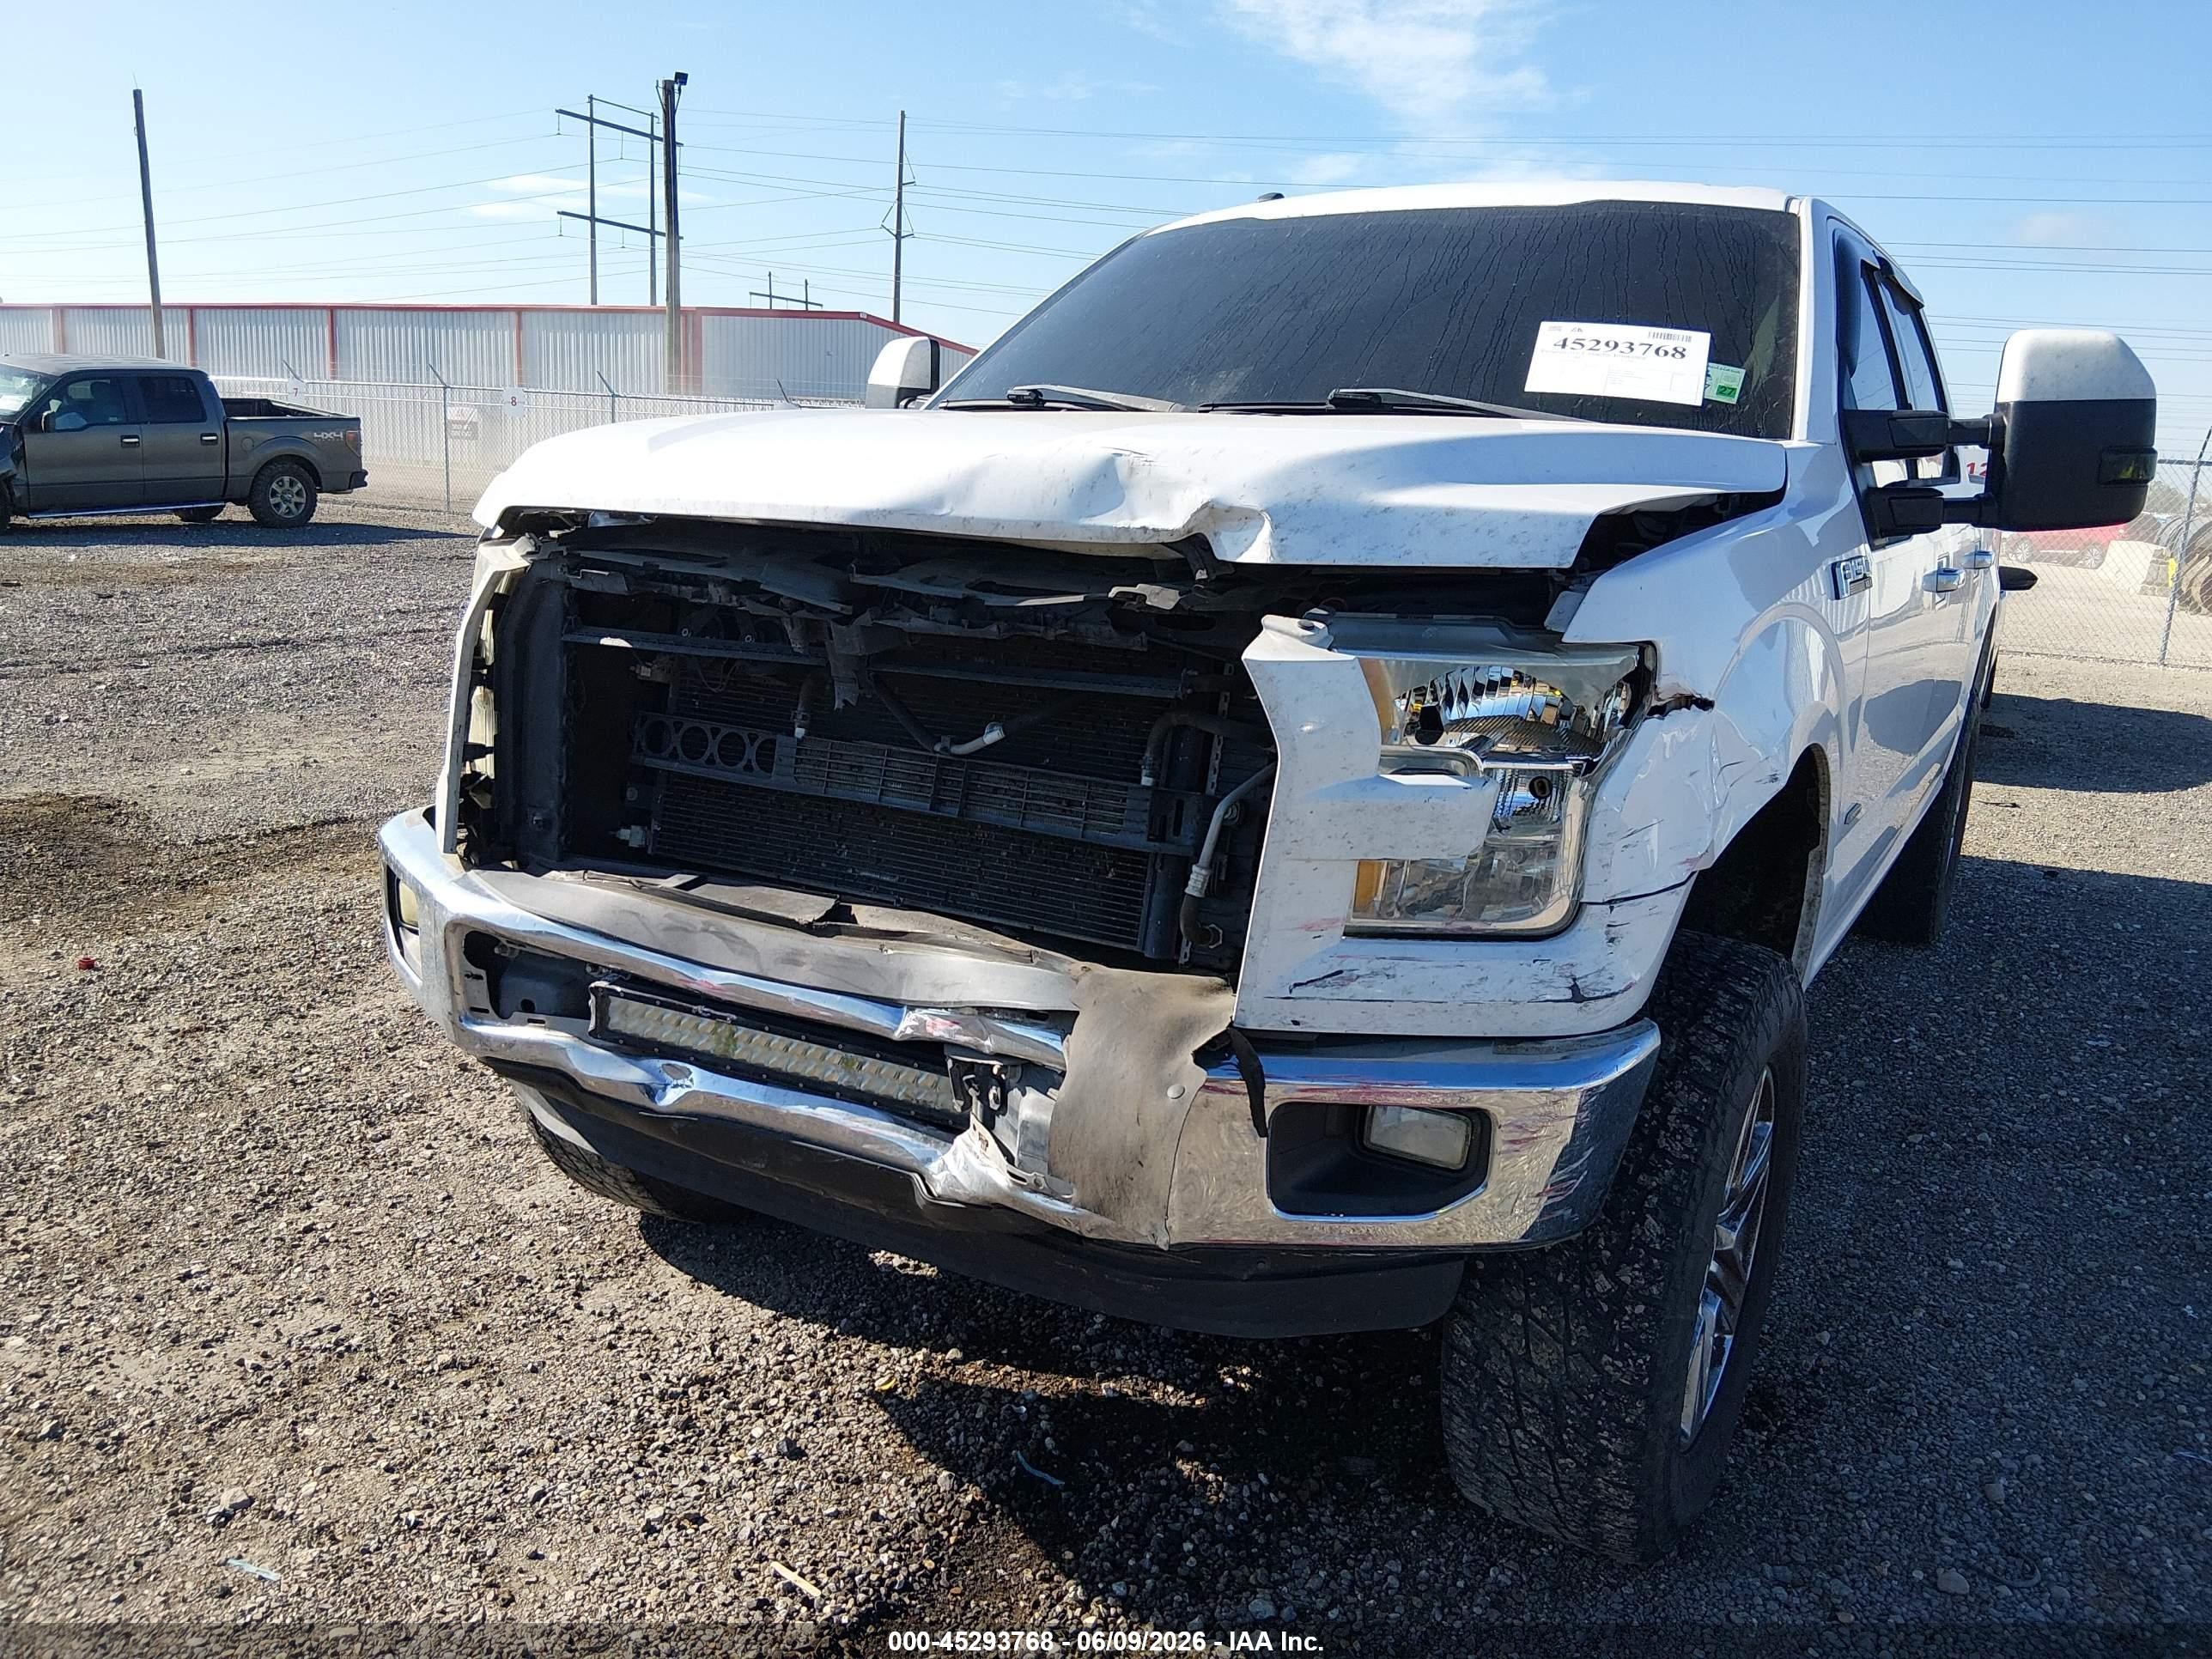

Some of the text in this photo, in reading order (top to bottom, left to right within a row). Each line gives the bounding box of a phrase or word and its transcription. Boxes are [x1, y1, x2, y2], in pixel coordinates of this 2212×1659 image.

[1553, 337, 1687, 360] 45293768
[1718, 386, 1735, 397] 27
[510, 396, 517, 407] 8
